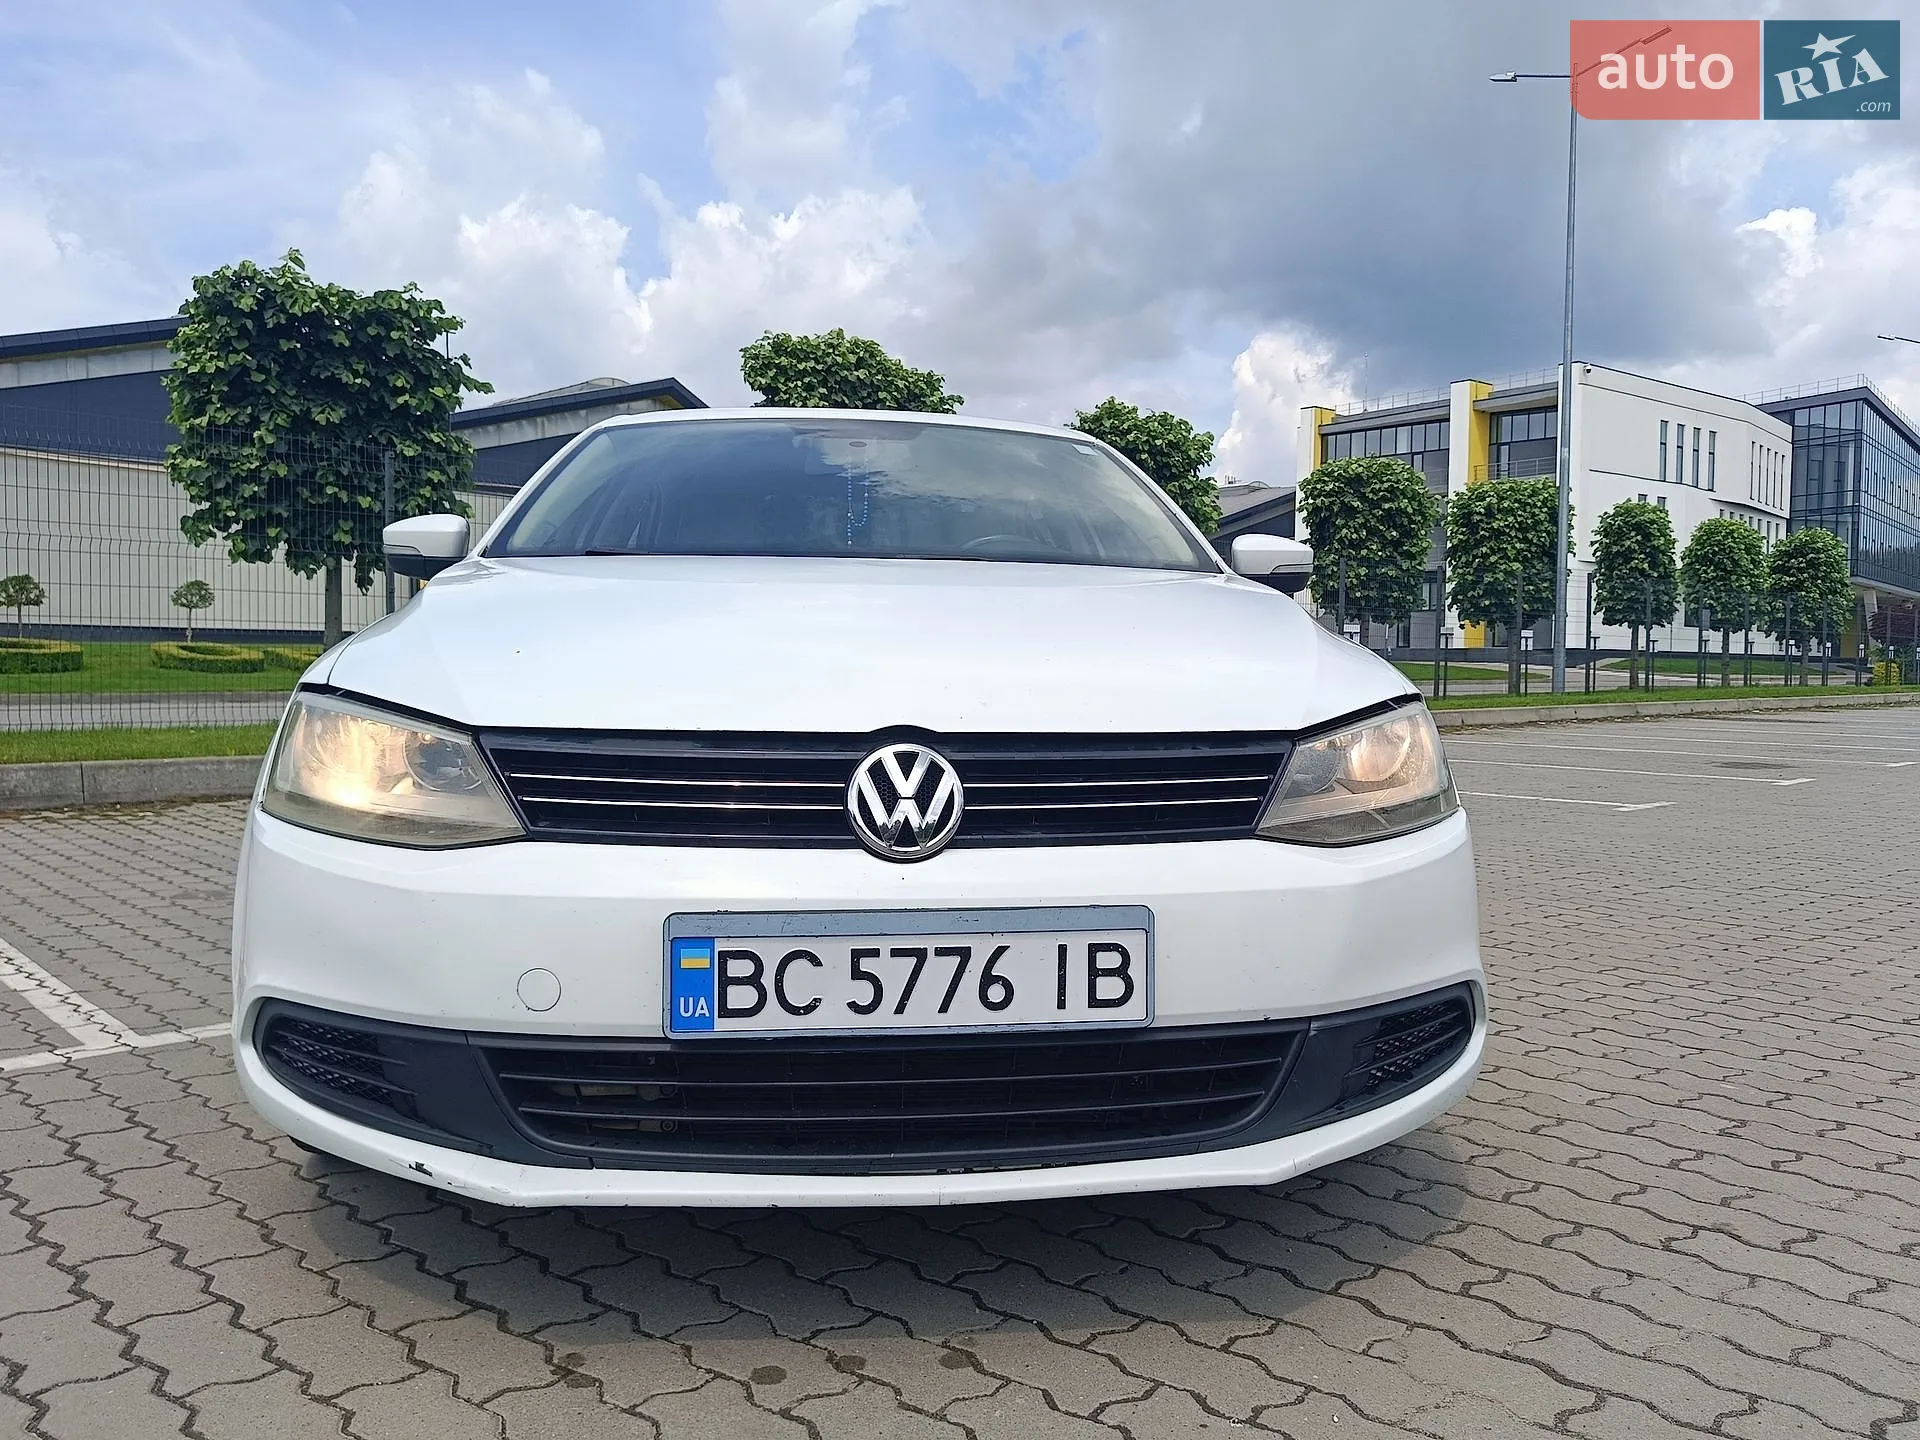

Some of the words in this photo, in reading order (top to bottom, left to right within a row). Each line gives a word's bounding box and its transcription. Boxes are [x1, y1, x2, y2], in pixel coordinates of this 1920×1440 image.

[717, 949, 824, 1019] BC
[846, 945, 1015, 1015] 5776
[1056, 942, 1135, 1010] IB
[679, 997, 709, 1018] UA
